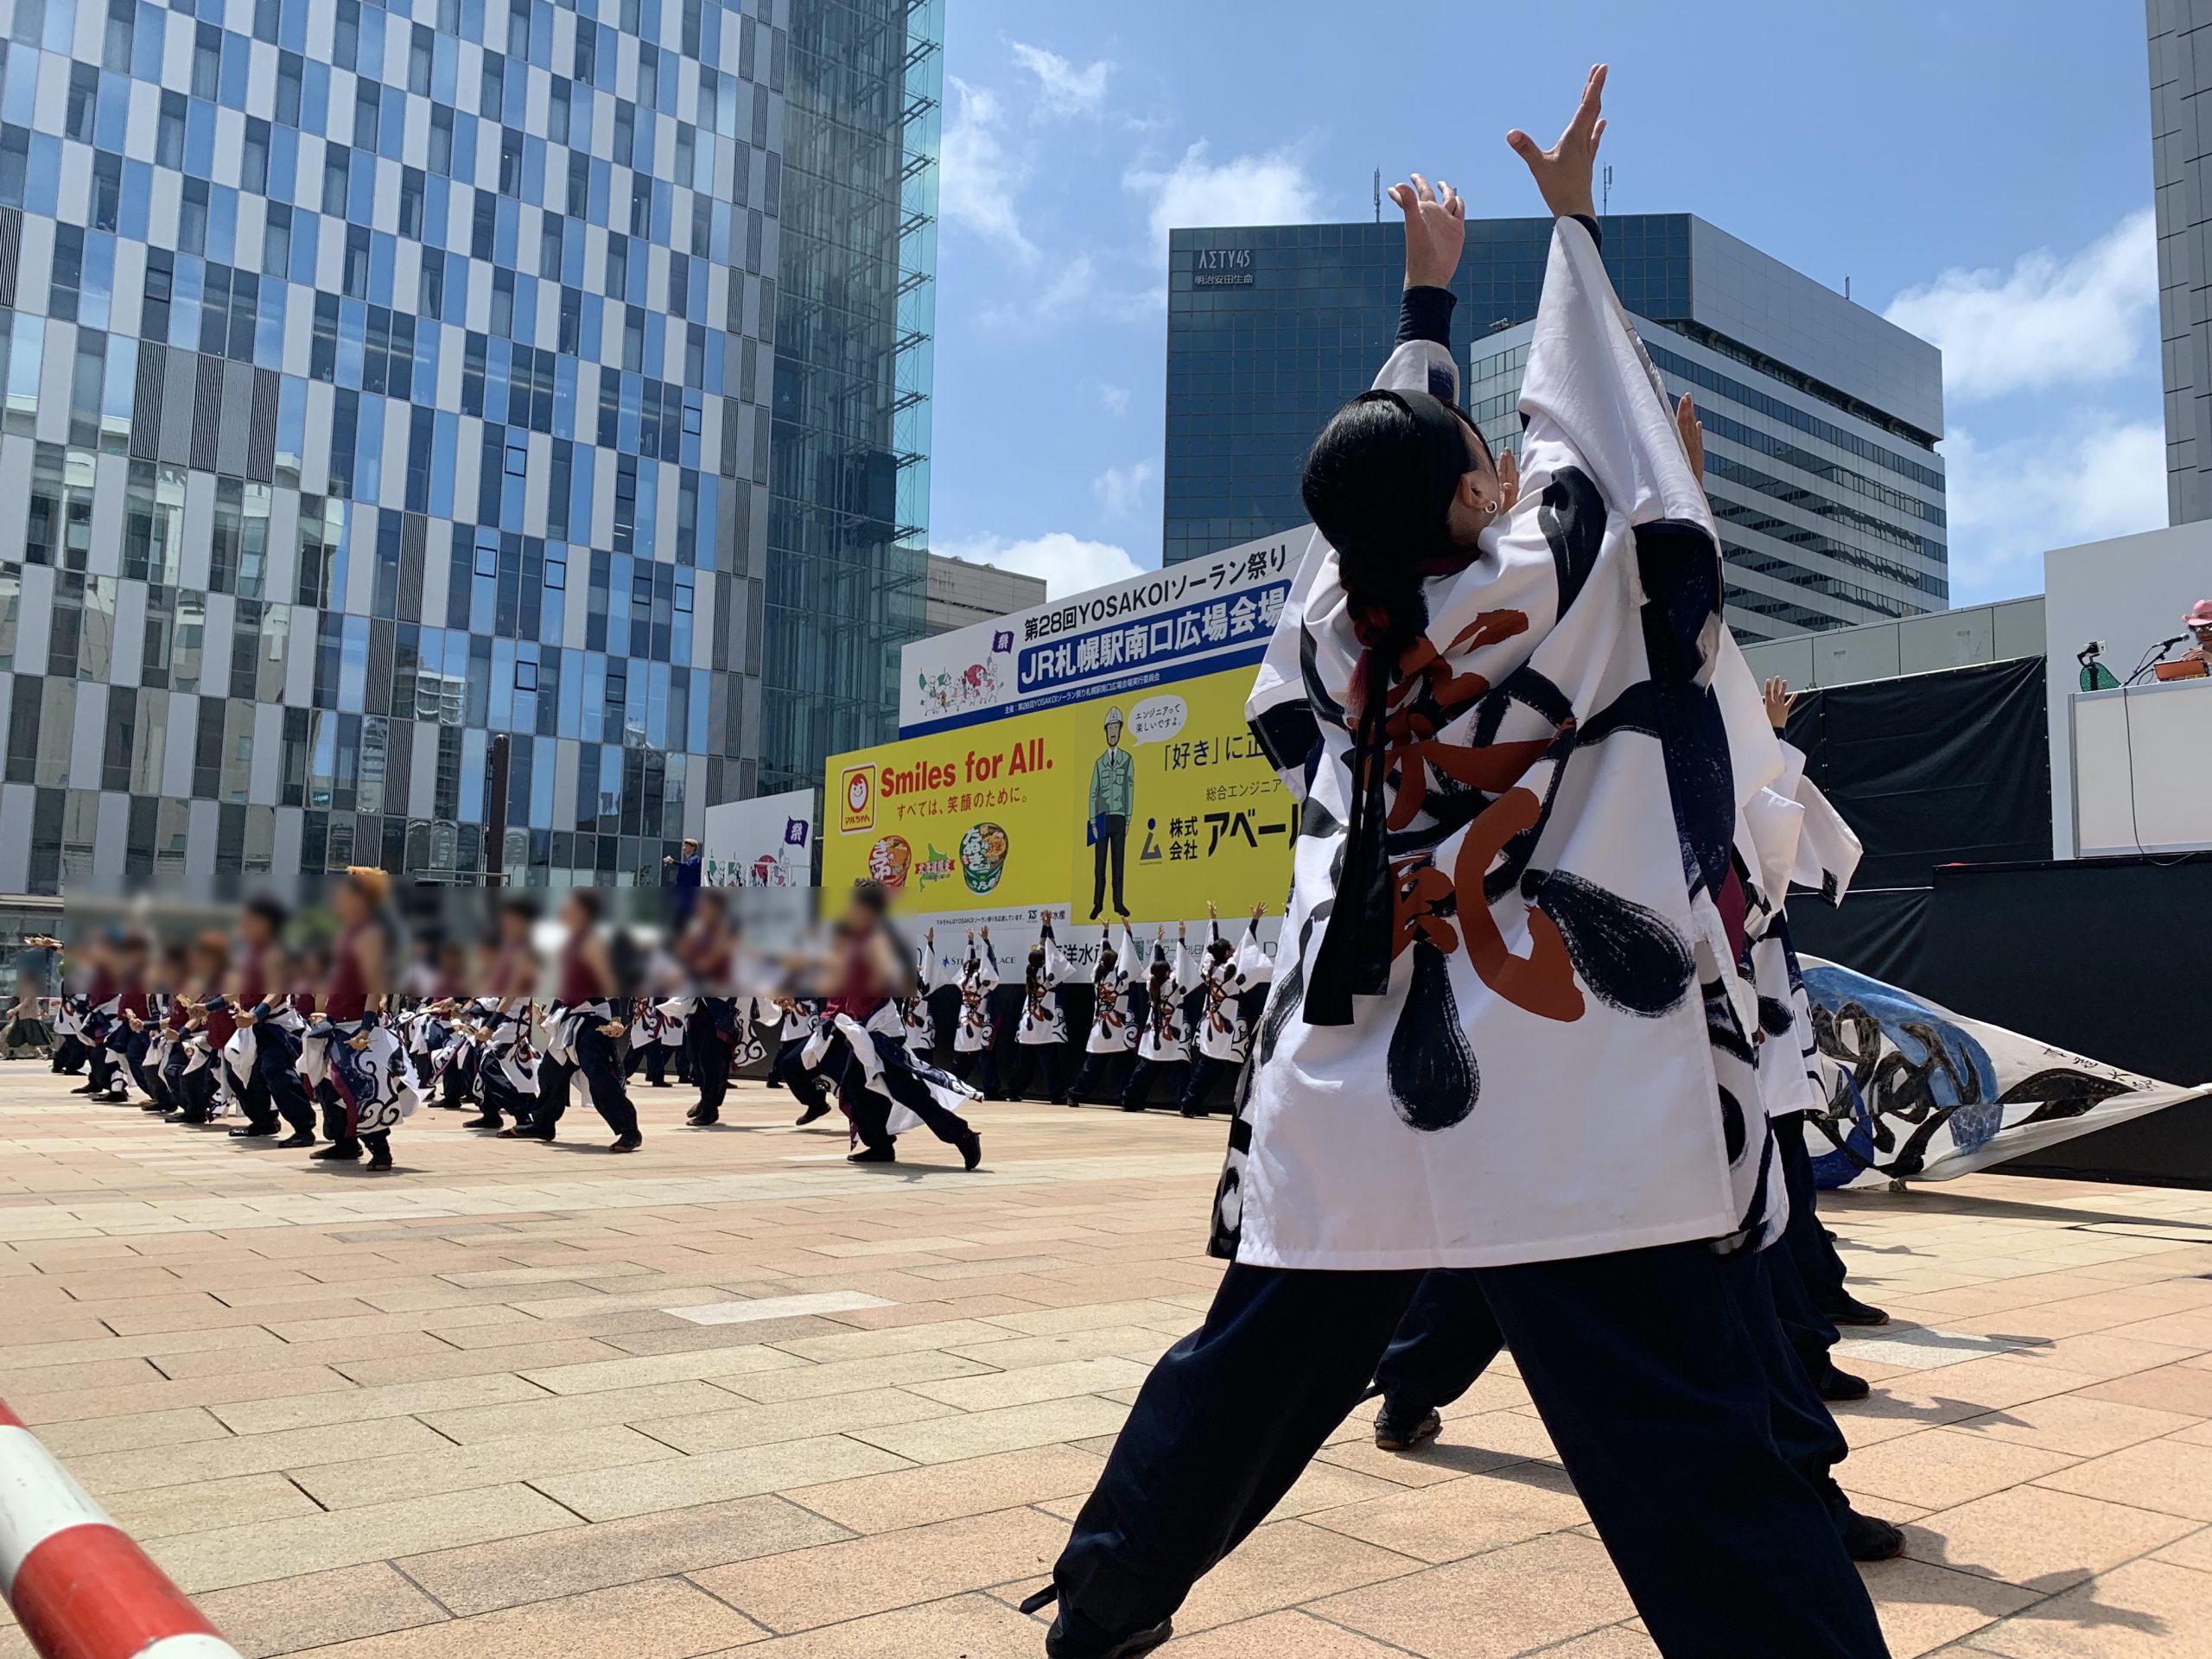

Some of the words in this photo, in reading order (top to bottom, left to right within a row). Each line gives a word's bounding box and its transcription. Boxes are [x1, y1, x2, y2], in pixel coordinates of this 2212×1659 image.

[1194, 274, 1254, 285] 明治安田生命
[1024, 544, 1286, 642] 第28回YOSAKOIソーラン祭り
[997, 632, 1010, 649] 祭
[1021, 587, 1285, 684] JR札幌駅南口広場会場
[1135, 703, 1181, 720] エンジニアって
[1135, 717, 1182, 734] 楽しいですよ。
[880, 760, 956, 798] Smiles
[965, 750, 1003, 783] for
[1008, 738, 1053, 776] All.
[1206, 779, 1289, 802] 総合エンジニア
[897, 787, 1027, 821] すべては、笑顔のために。
[844, 814, 870, 825] マルちゃん
[1169, 816, 1198, 838] 株式
[790, 823, 803, 841] 祭
[963, 827, 984, 871] たぬき
[1169, 839, 1198, 861] 会社
